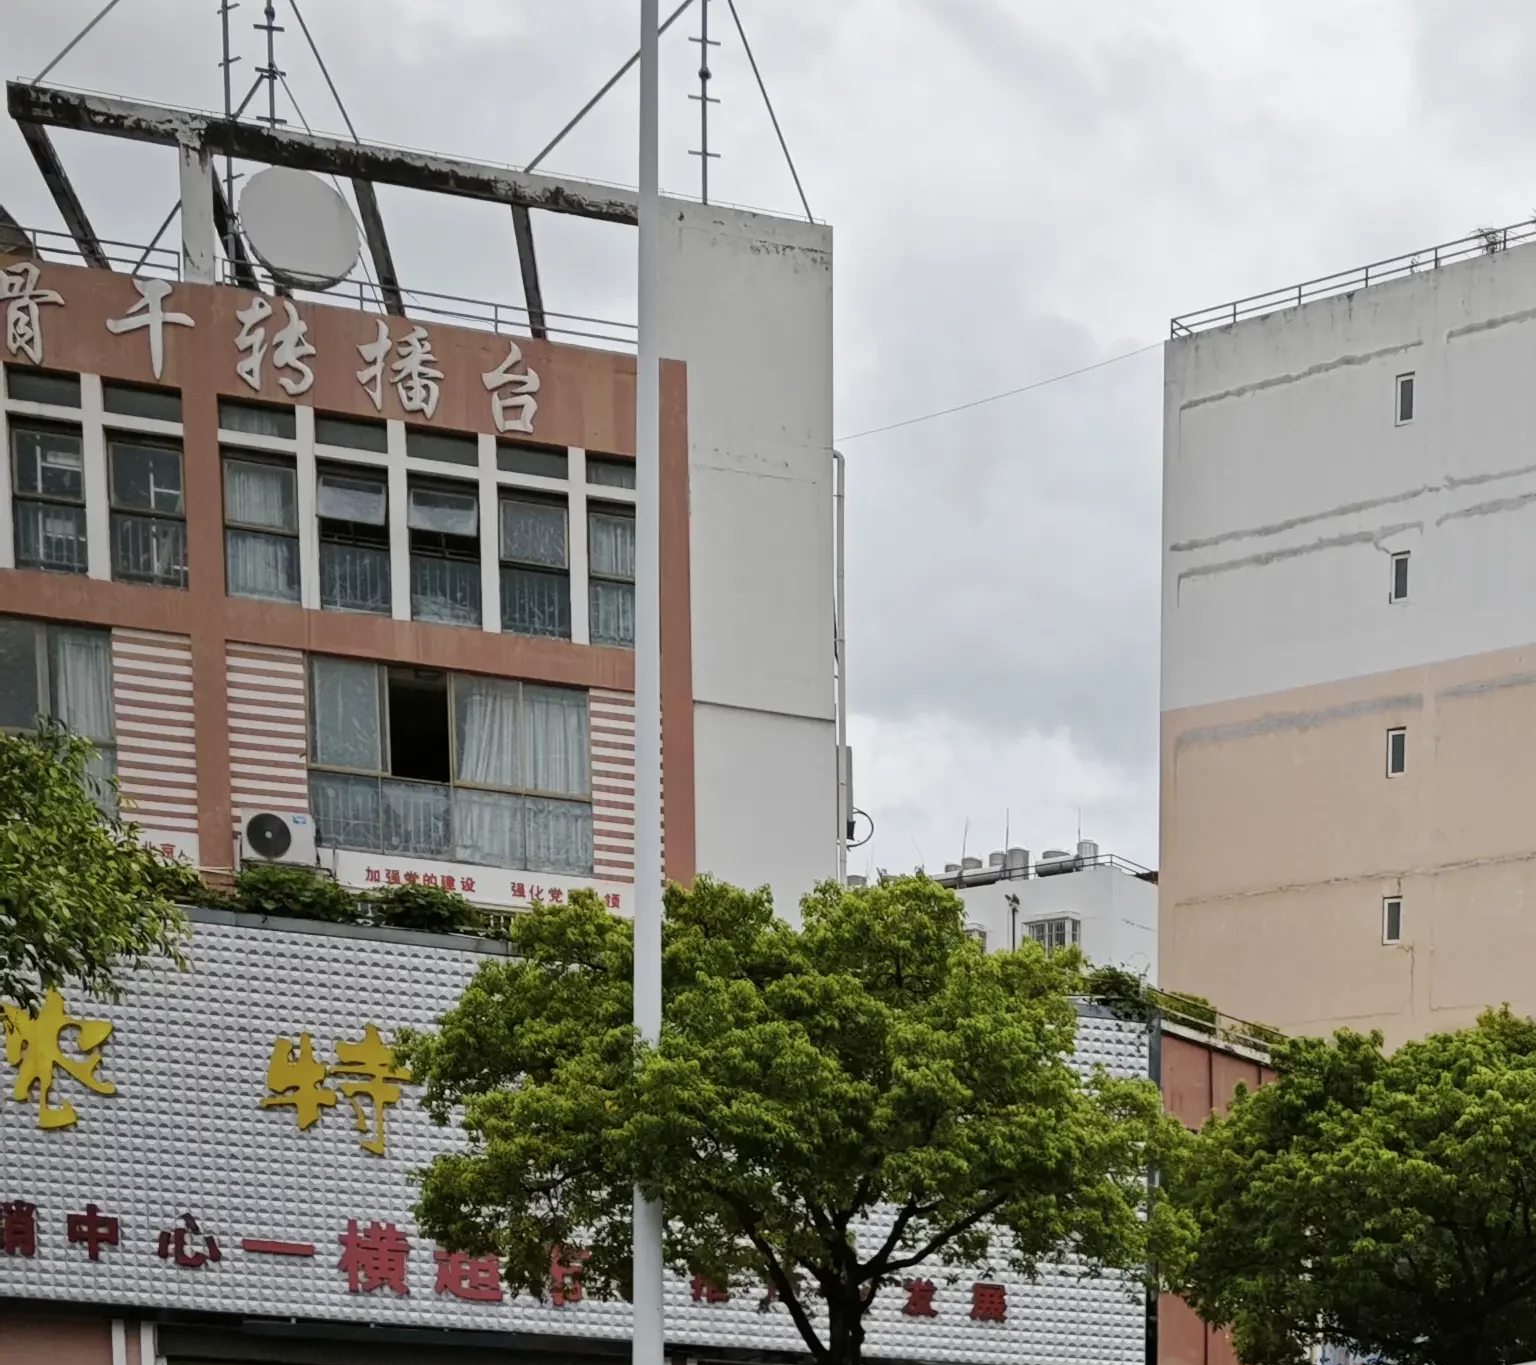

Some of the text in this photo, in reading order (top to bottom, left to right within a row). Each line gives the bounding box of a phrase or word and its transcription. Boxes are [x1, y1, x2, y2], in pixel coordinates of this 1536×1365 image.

[0, 262, 541, 435] 骨干转播台
